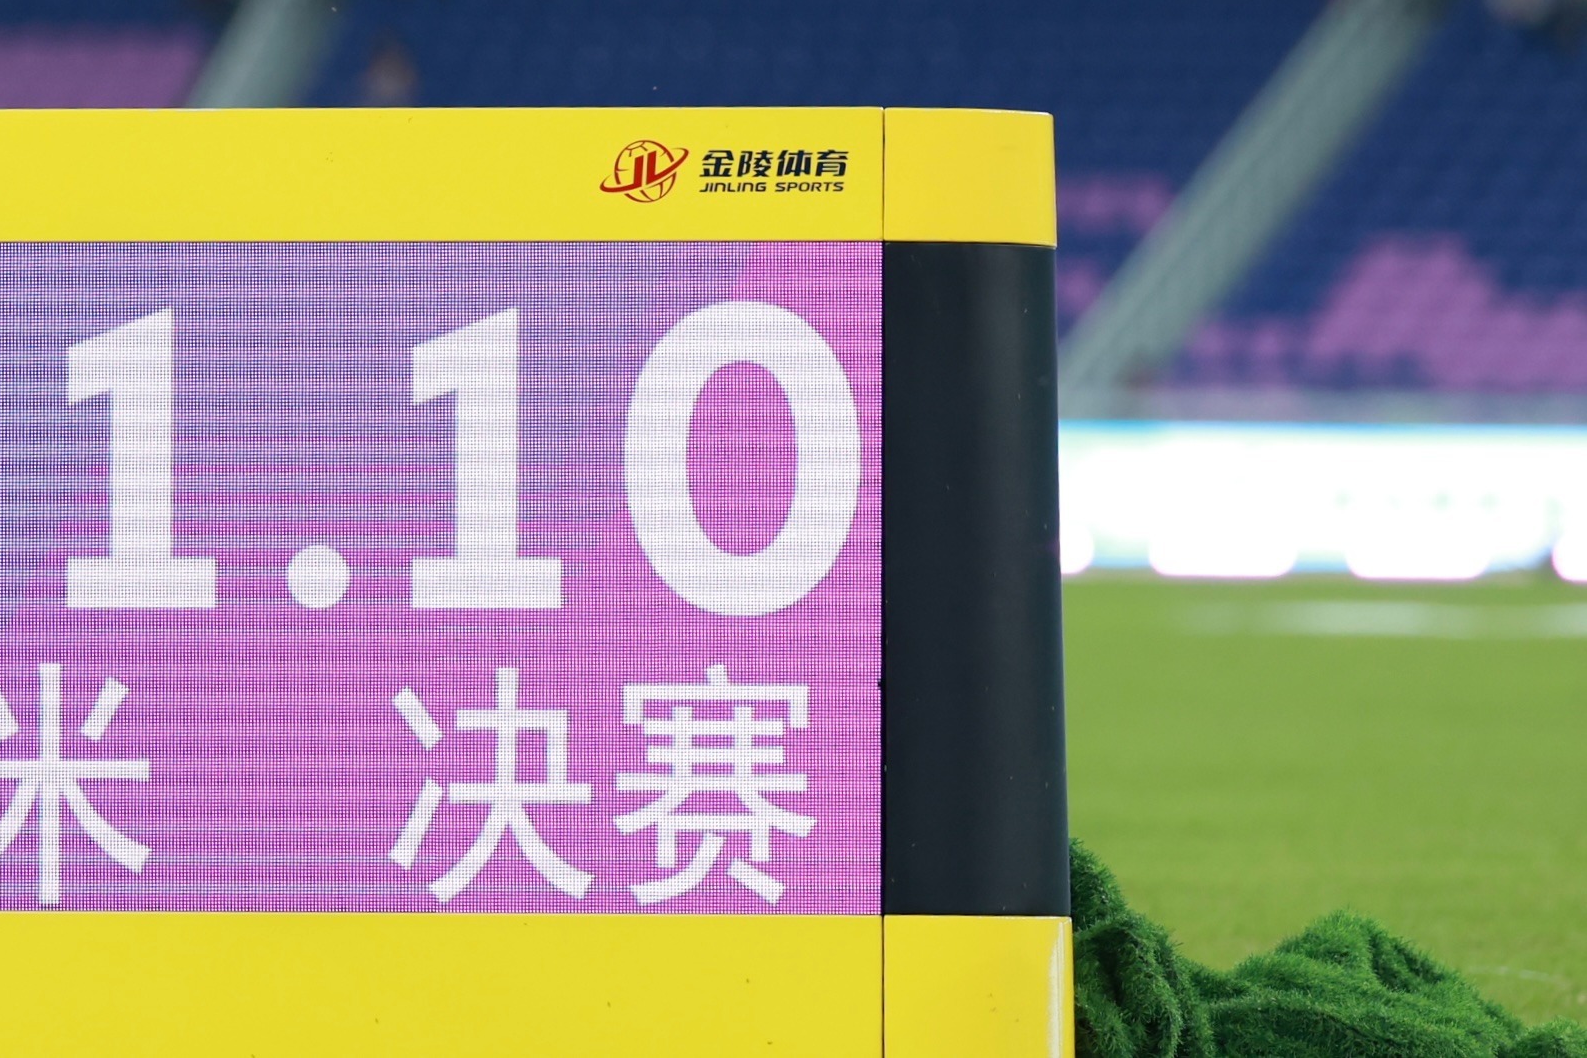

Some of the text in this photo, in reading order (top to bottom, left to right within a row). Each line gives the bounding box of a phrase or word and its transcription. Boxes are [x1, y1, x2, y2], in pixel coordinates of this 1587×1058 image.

[699, 149, 849, 178] 金陵体育
[698, 181, 844, 193] JINLING SPORTS
[388, 664, 818, 906] 决赛
